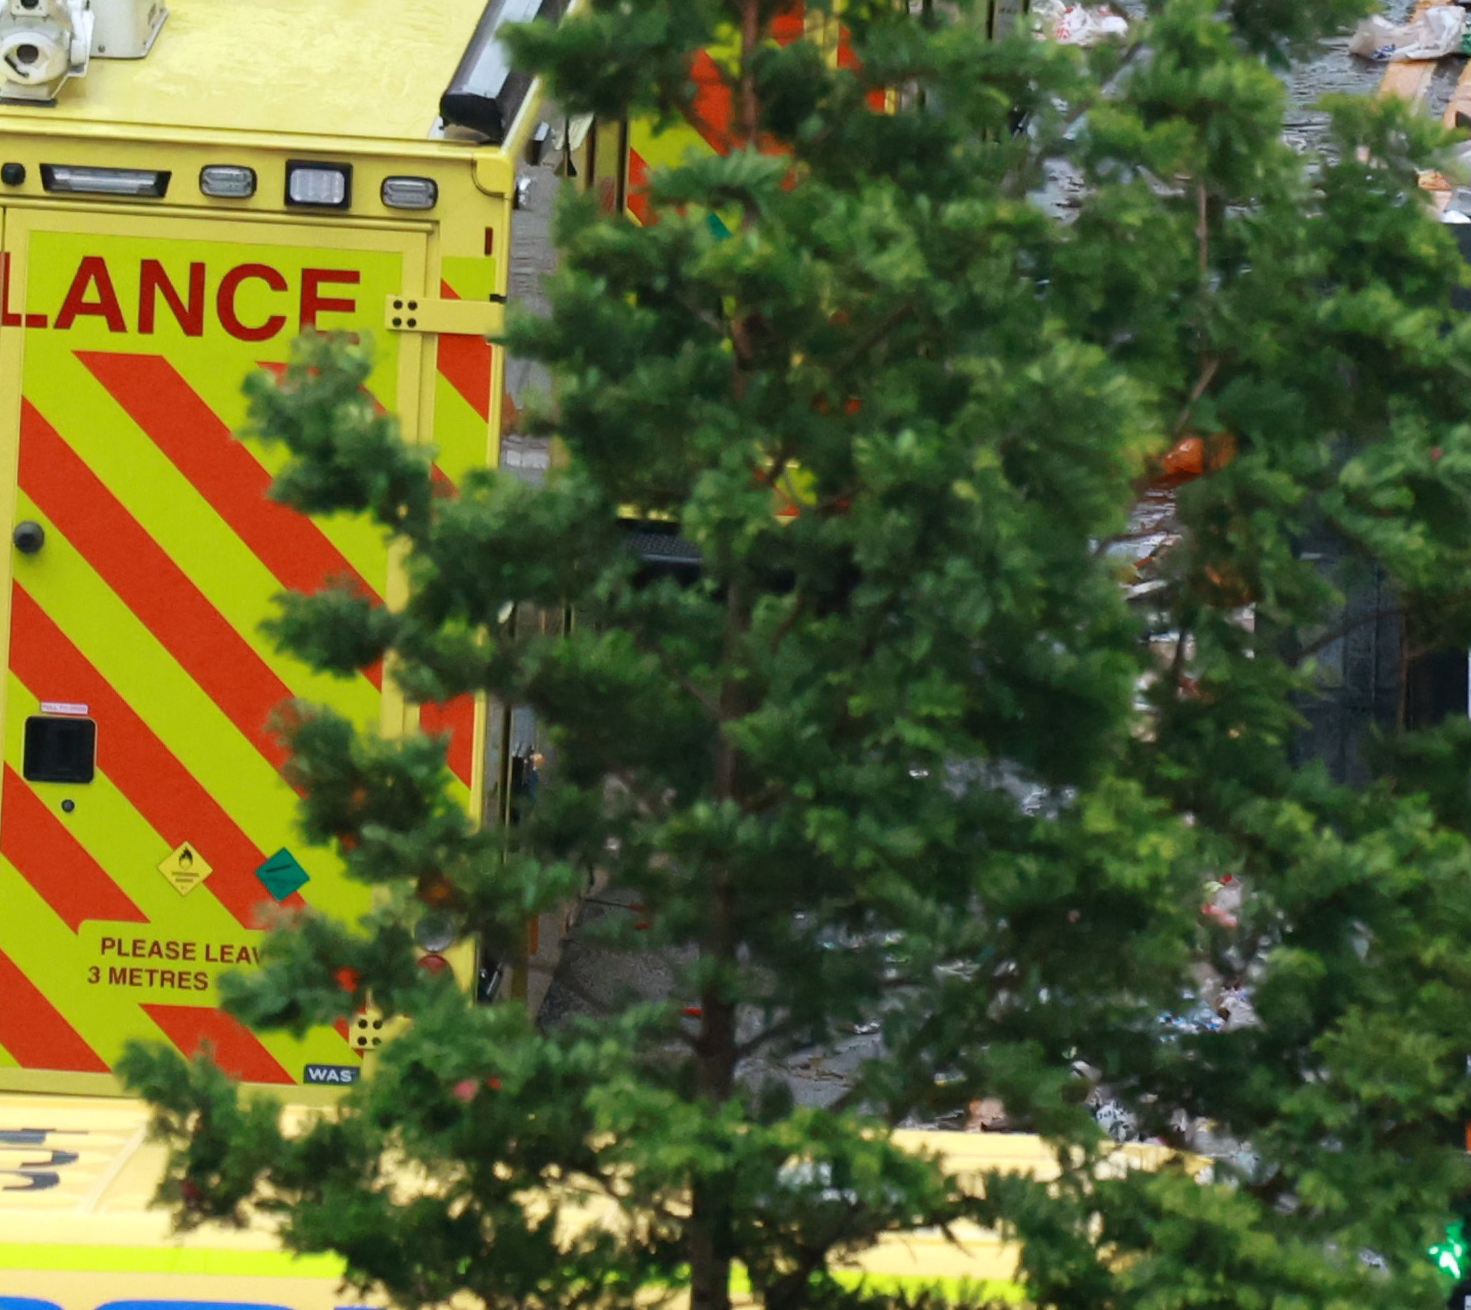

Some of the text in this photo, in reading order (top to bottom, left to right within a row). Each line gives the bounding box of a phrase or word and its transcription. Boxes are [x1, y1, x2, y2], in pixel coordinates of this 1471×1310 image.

[101, 937, 262, 965] PLEASE LEAV
[87, 966, 208, 991] 3 METRES
[308, 1067, 352, 1082] WAS
